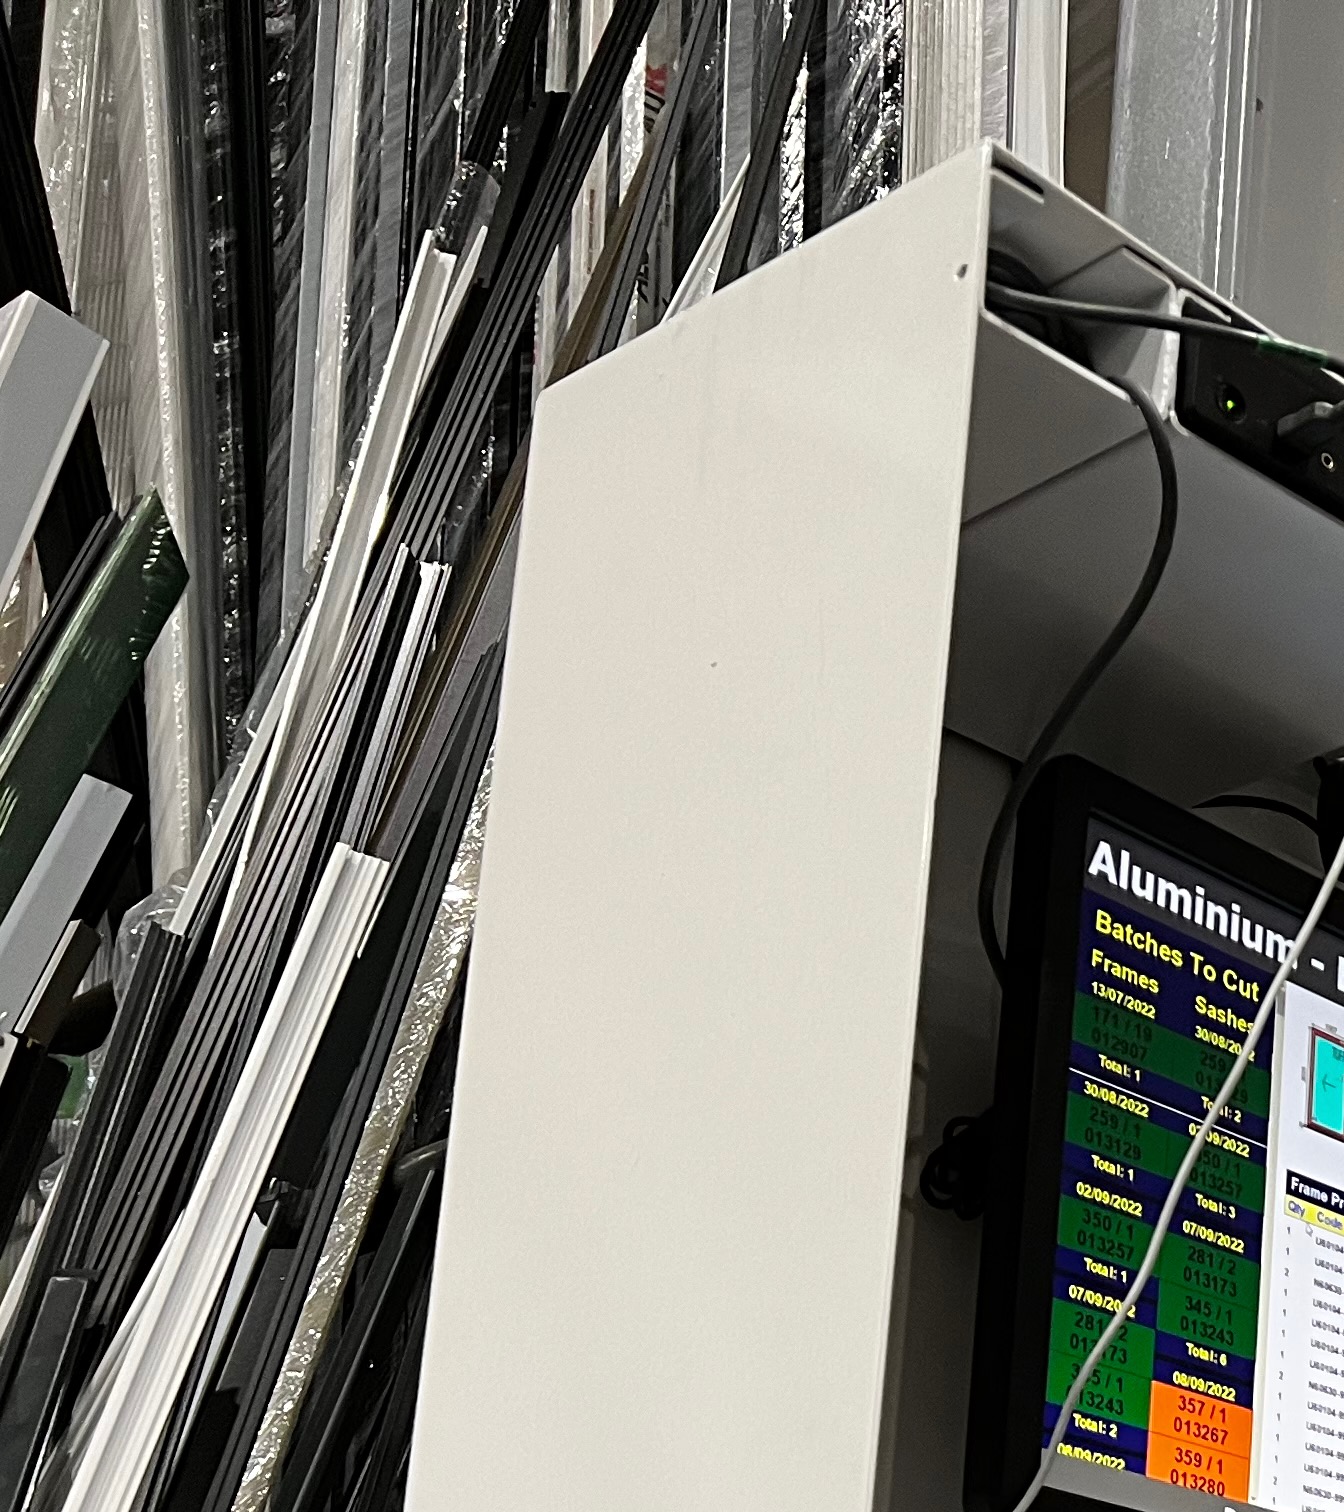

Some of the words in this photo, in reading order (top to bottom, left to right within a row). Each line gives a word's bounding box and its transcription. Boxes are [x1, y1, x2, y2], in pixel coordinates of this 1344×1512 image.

[1095, 909, 1184, 968] Batches
[1189, 950, 1217, 984] To
[1222, 967, 1259, 1002] Cut
[1310, 956, 1324, 973] -
[1091, 949, 1159, 994] Frames
[1090, 979, 1156, 1019] 13/07/2022
[1194, 995, 1254, 1036] Sashes
[1194, 1024, 1255, 1061] 30/08/202
[1098, 1054, 1132, 1079] Total:
[1134, 1067, 1141, 1083] 1
[1083, 1080, 1149, 1117] 30/08/2022
[1200, 1096, 1233, 1120] Toal:
[1234, 1108, 1241, 1124] 2
[1090, 1155, 1125, 1178] Total:
[1127, 1167, 1134, 1183] 1
[1195, 1146, 1219, 1170] 50
[1076, 1180, 1143, 1216] 02/09/2022
[1290, 1176, 1328, 1203] Frame
[1082, 1208, 1112, 1232] 350
[1195, 1193, 1227, 1216] Total:
[1228, 1205, 1236, 1220] 3
[1316, 1211, 1343, 1230] Code
[1076, 1228, 1134, 1262] 013257
[1182, 1219, 1244, 1253] 07/09/2022
[1083, 1258, 1118, 1281] Total:
[1120, 1269, 1127, 1284] 1
[1187, 1245, 1213, 1268] 281
[1226, 1258, 1236, 1276] 2
[1183, 1264, 1237, 1297] 013173
[1068, 1284, 1136, 1317] 07/09/202
[1185, 1294, 1210, 1317] 345
[1179, 1314, 1234, 1345] 013243
[1185, 1342, 1218, 1363] Total:
[1219, 1352, 1227, 1367] 6
[1070, 1362, 1101, 1386] 35
[1172, 1370, 1236, 1401] 08/09/2022
[1177, 1394, 1205, 1416] 357
[1218, 1406, 1226, 1424] 1
[1072, 1413, 1107, 1435] Total:
[1108, 1422, 1118, 1439] 2
[1173, 1415, 1228, 1446] 013267
[1174, 1447, 1202, 1468] 359
[1215, 1457, 1223, 1475] 1
[1170, 1468, 1225, 1497] 013280
